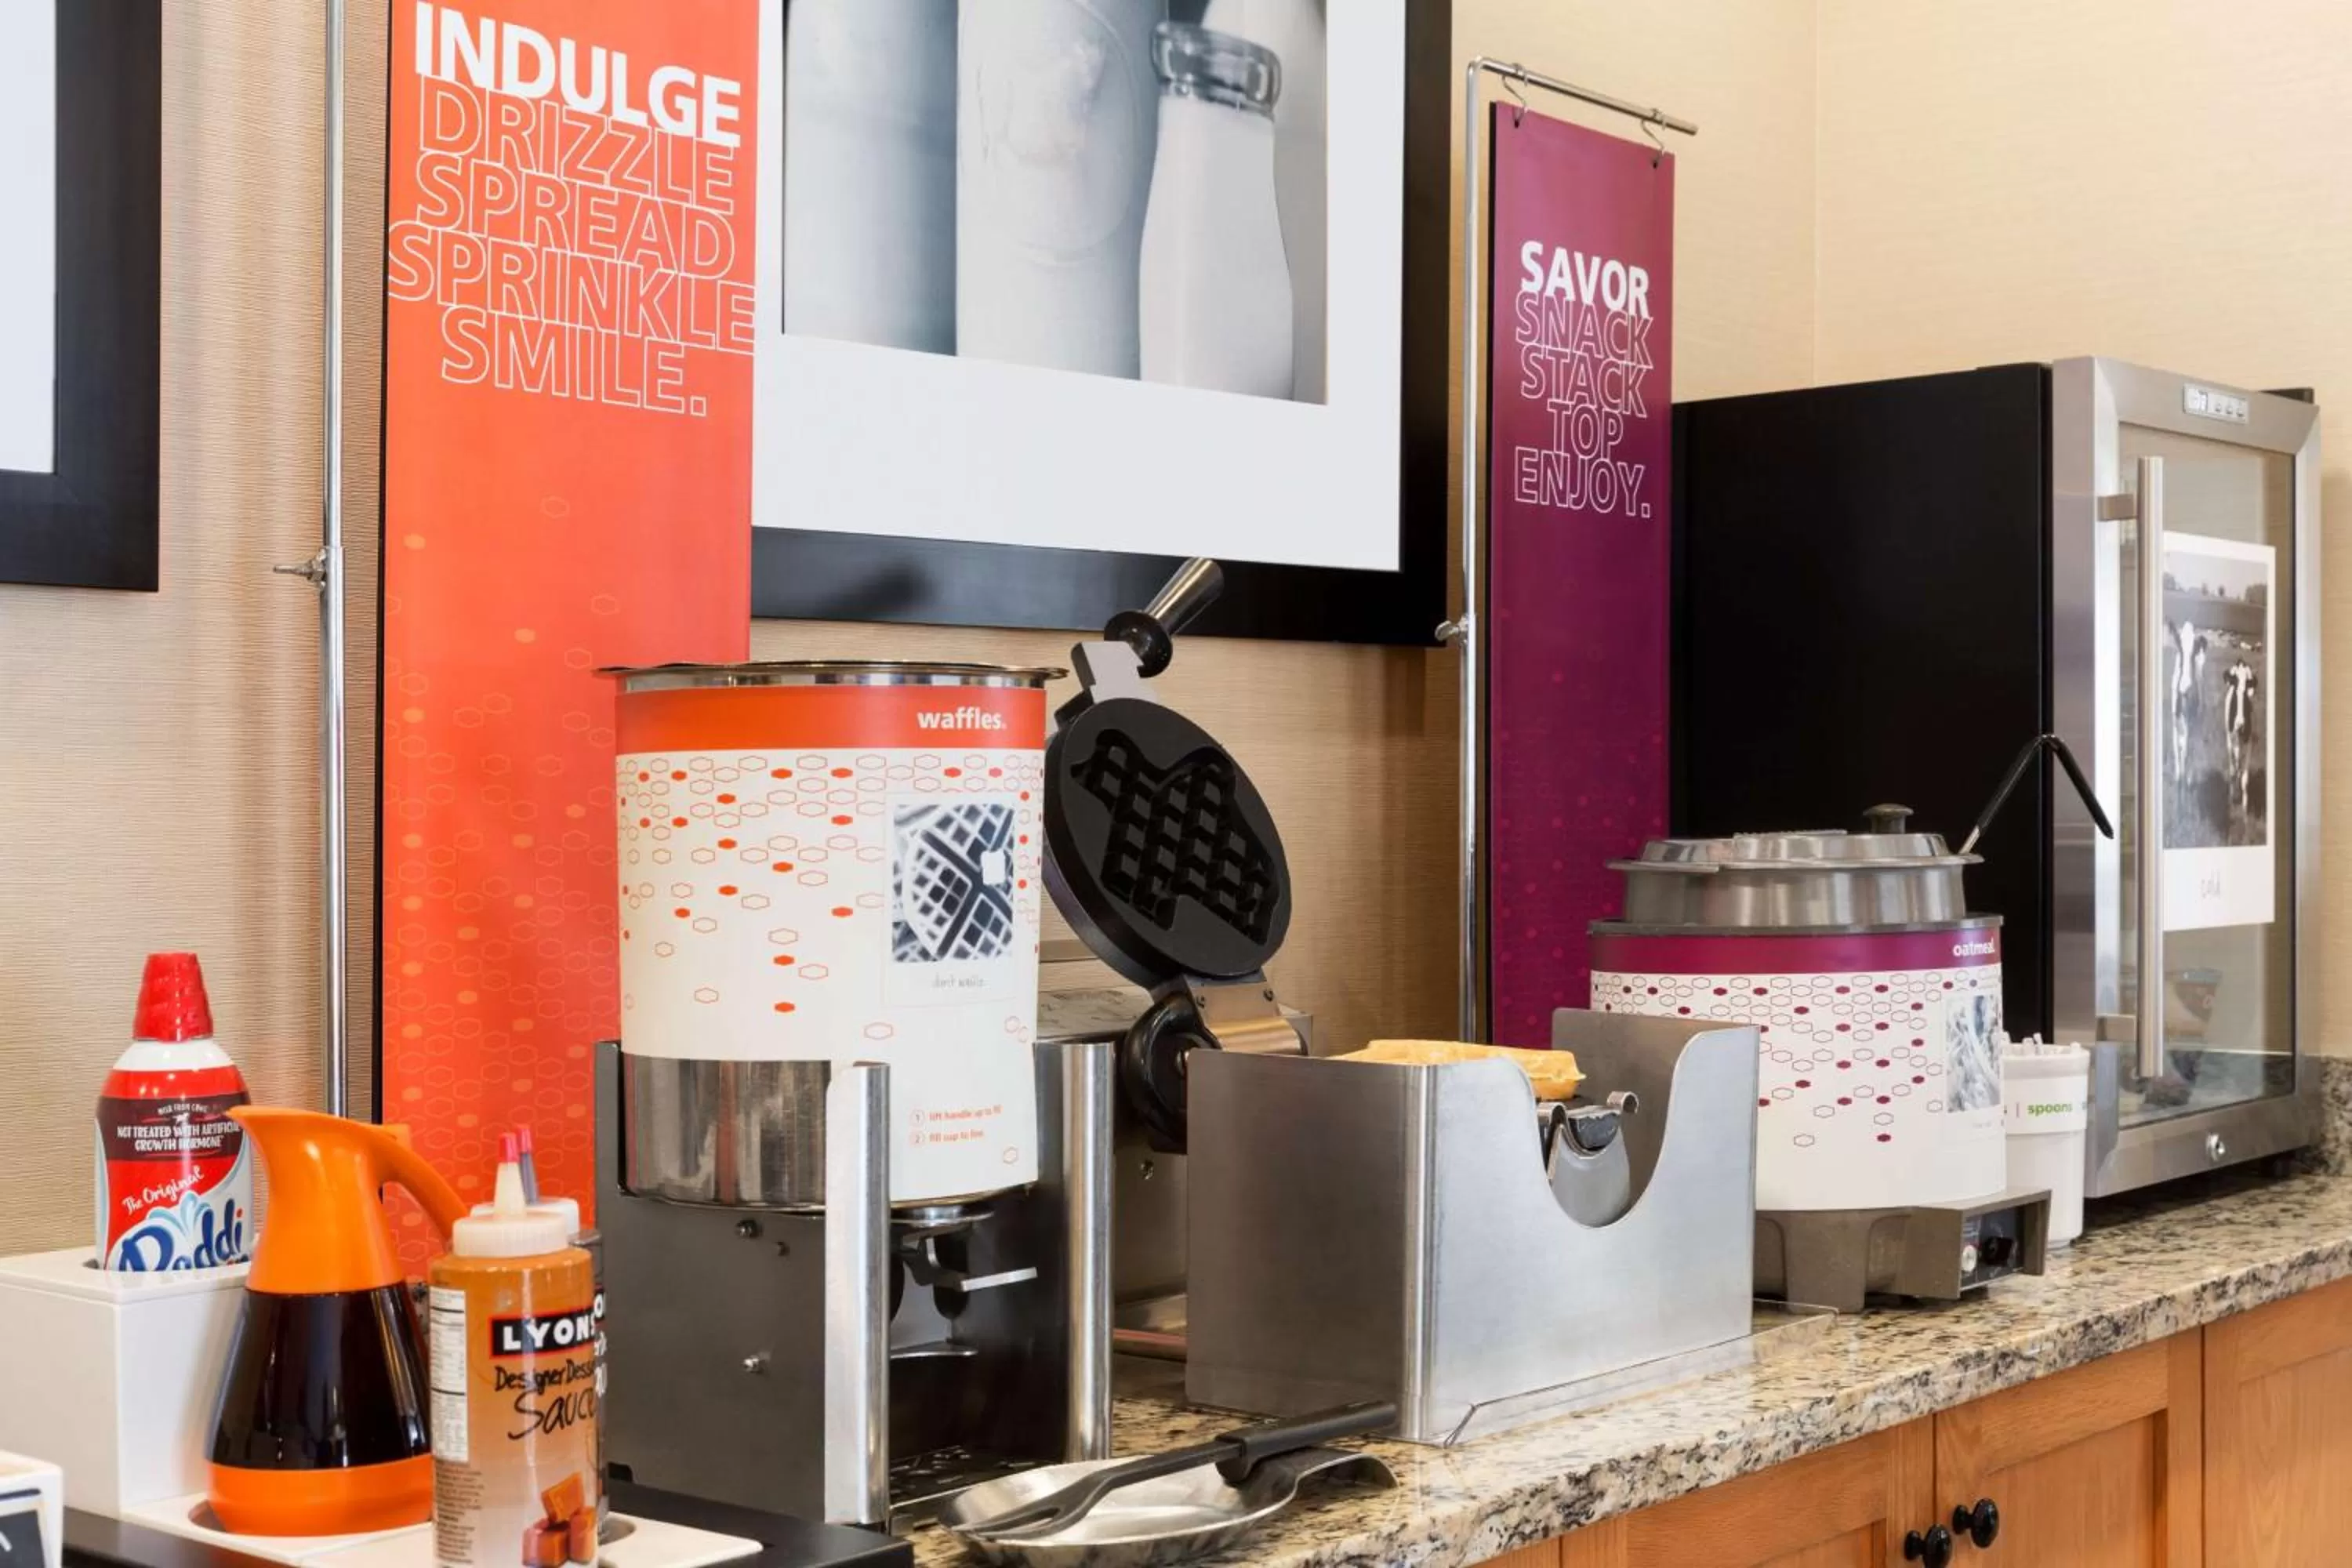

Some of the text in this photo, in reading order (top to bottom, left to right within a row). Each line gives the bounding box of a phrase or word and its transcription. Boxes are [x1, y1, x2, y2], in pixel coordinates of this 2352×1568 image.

[416, 1, 741, 147] INDULGE
[419, 74, 734, 215] DRIZZLE
[416, 150, 735, 279] SPREAD
[388, 220, 755, 356] SPRINKLE
[1520, 241, 1650, 320] SAVOR
[441, 304, 706, 417] SMILE.
[1515, 290, 1653, 368] SNACK
[1520, 343, 1647, 418] STACK
[1547, 399, 1623, 461] TOP
[1515, 446, 1651, 518] ENJOY.
[117, 1126, 131, 1139] NOT
[132, 1125, 172, 1138] TREATED
[173, 1124, 200, 1137] WITH
[134, 1139, 176, 1152] GROWTH
[122, 1165, 205, 1215] The Original
